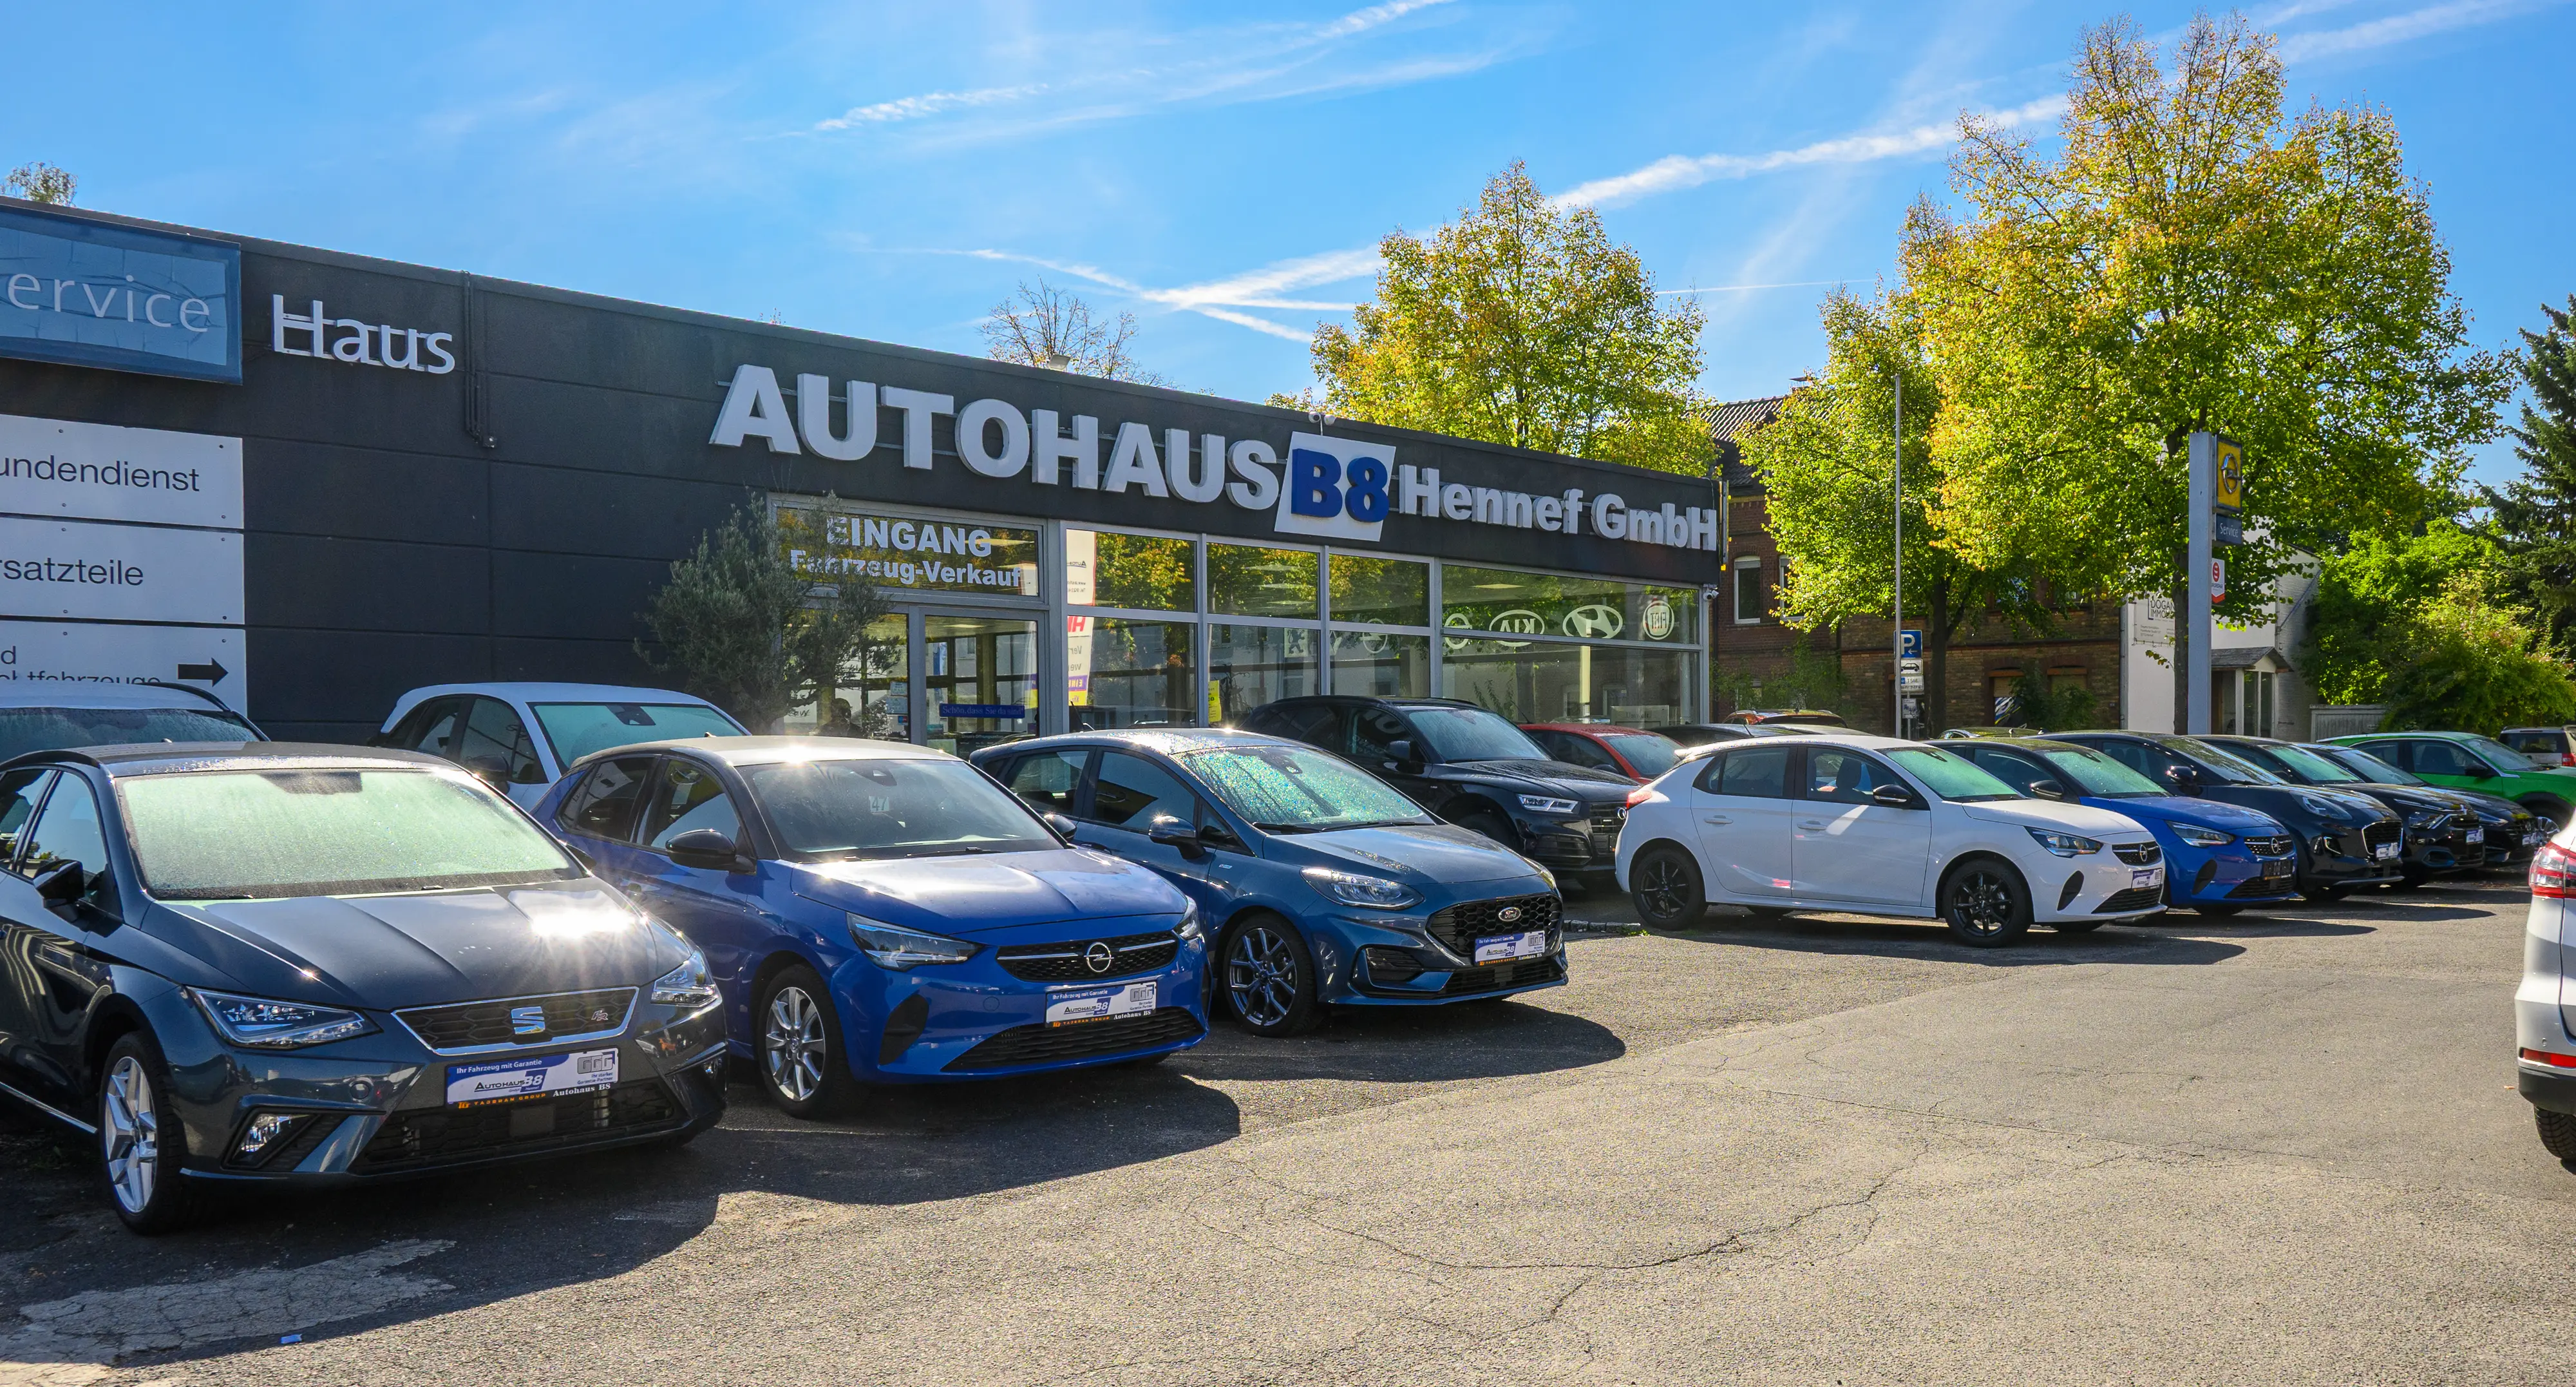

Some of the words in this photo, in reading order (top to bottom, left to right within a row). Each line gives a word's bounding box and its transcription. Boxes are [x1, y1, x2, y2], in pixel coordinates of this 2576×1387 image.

[8, 273, 210, 333] ervice
[272, 294, 455, 374] Haus
[708, 363, 1279, 510] AUTOHAUS
[1290, 448, 1390, 523] B8
[1398, 464, 1584, 534] Hennef
[1591, 493, 1718, 551] GmbH
[827, 515, 991, 557] EINGANG
[2220, 522, 2239, 538] Service
[0, 557, 144, 586] satzteile
[2150, 599, 2175, 610] DOGAN
[1900, 633, 1915, 655] P
[985, 706, 996, 714] Sie
[591, 1009, 609, 1021] FR
[468, 1064, 500, 1073] Fahrzeug
[513, 1058, 542, 1067] Garantie
[475, 1080, 526, 1090] AUTOHAUS
[518, 1093, 546, 1101] GROUP
[553, 1086, 596, 1097] Autohaus
